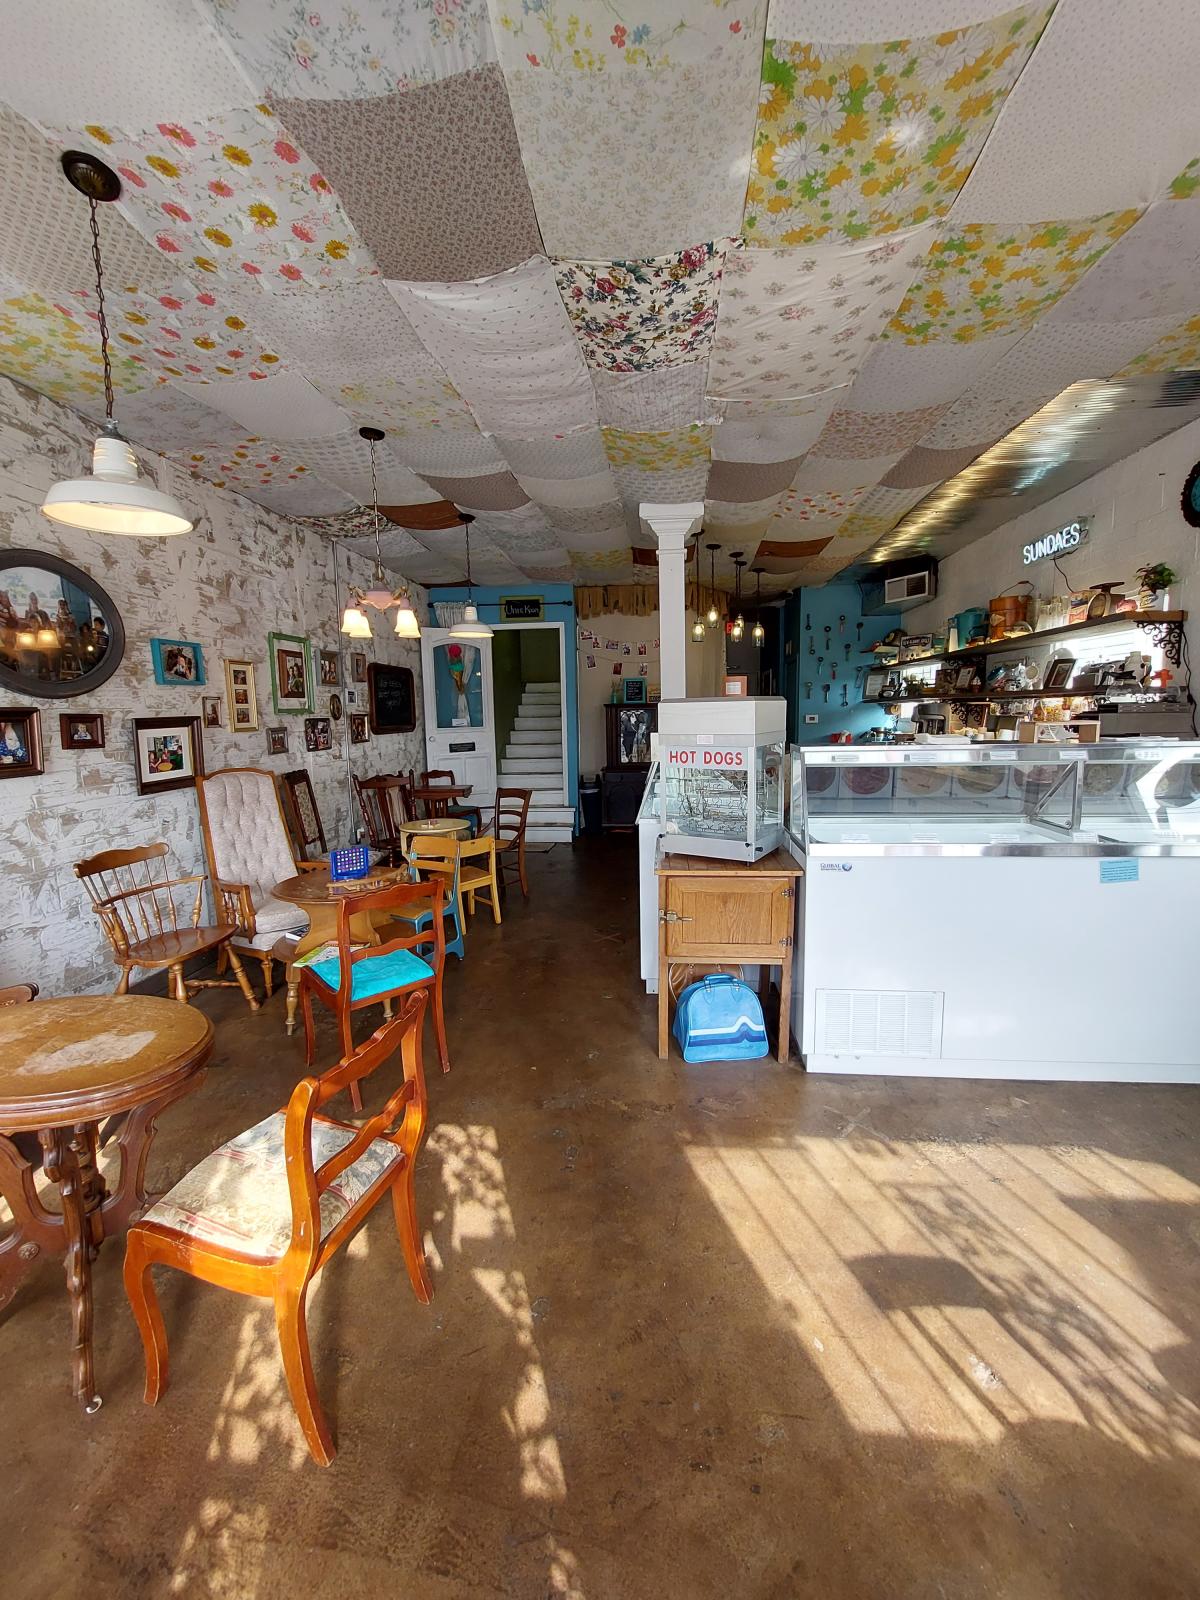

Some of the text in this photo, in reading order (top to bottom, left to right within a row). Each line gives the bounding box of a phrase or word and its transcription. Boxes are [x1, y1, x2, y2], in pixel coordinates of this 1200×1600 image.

[1023, 522, 1080, 565] SUNDAES
[669, 750, 743, 766] HOT DOGS
